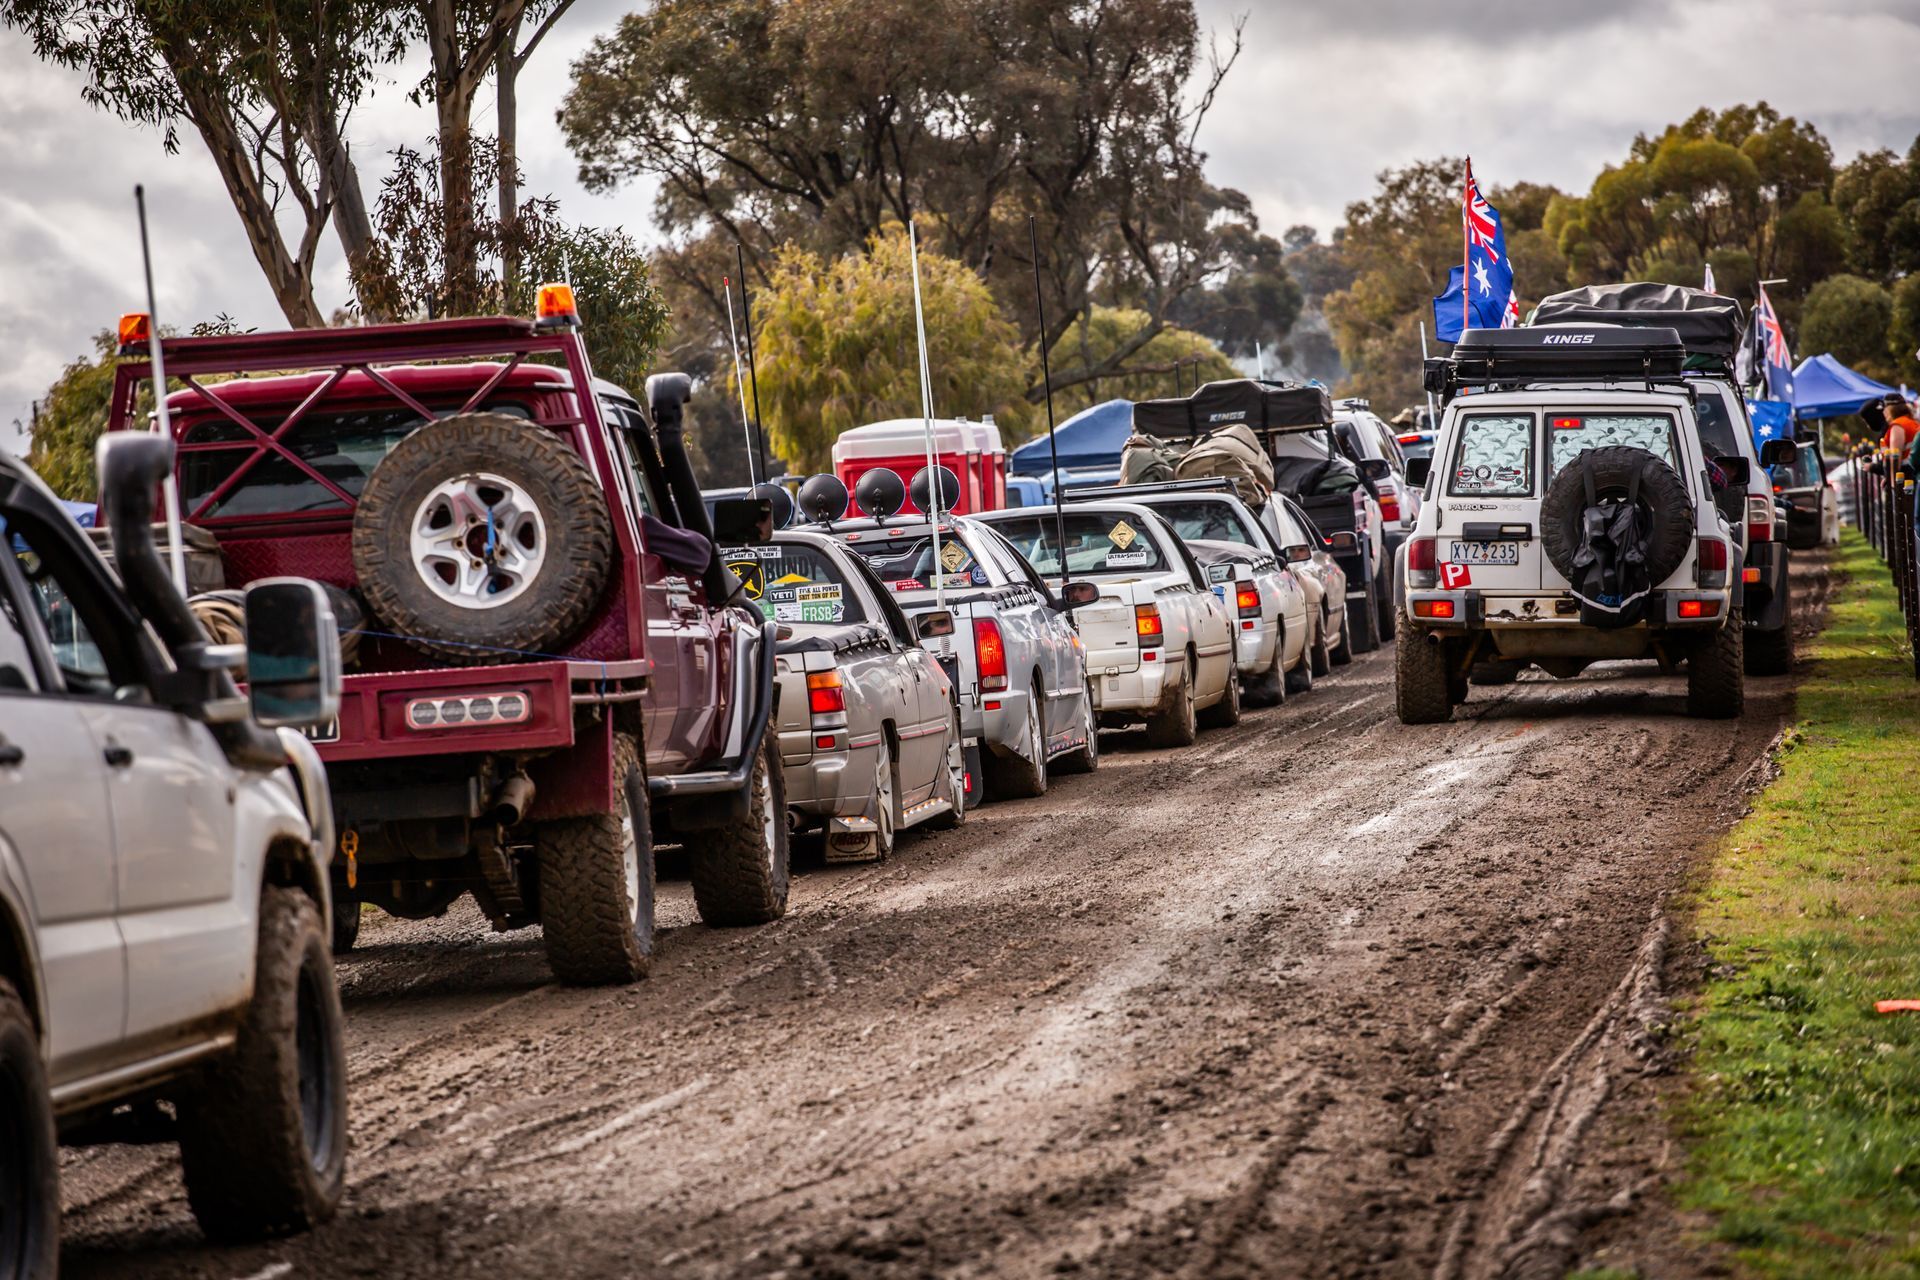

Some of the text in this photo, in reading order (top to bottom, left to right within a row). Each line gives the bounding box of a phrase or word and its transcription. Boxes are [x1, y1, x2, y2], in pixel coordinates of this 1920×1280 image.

[1542, 334, 1595, 344] KINGS
[1209, 411, 1246, 422] KINGS
[1448, 503, 1483, 512] PATROL
[1453, 544, 1516, 559] XYZ 235
[765, 556, 817, 584] BUNDY
[1445, 564, 1464, 587] P
[772, 590, 793, 600] YETI
[803, 606, 832, 621] FRSB
